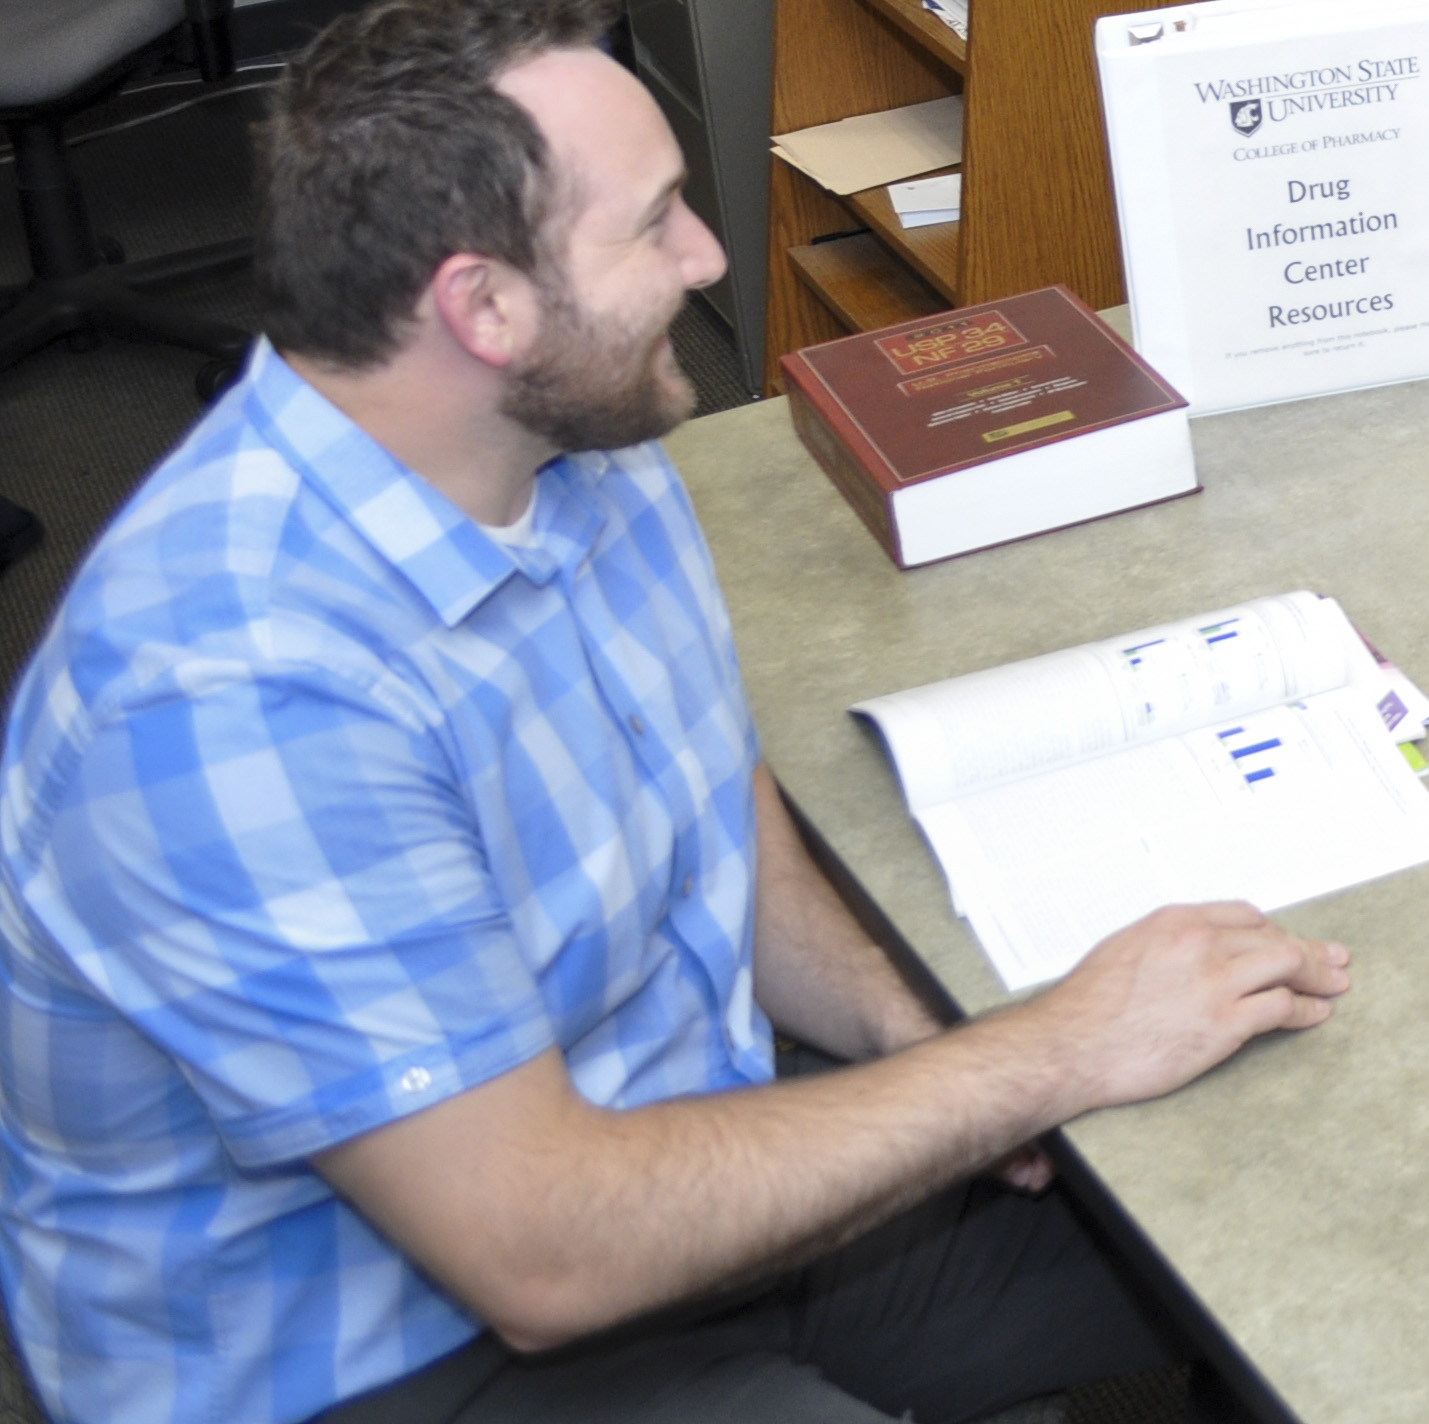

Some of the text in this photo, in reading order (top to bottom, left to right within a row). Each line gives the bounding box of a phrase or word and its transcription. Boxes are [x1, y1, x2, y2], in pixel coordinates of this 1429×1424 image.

[1194, 56, 1420, 104] WASHINGTON STATE
[1267, 83, 1399, 122] UNIVERSITY
[1233, 127, 1401, 162] COLLEGE OF PHARMACY
[1287, 179, 1351, 203] Drug
[1246, 211, 1398, 251] Information
[1284, 256, 1370, 285] Center
[1268, 293, 1394, 328] Resources
[891, 322, 1006, 358] USP 34
[913, 335, 1006, 366] NF 29
[1250, 345, 1279, 355] remove
[1282, 339, 1315, 351] anything
[1317, 336, 1335, 344] from
[1393, 324, 1418, 333] please
[1333, 342, 1355, 351] return
